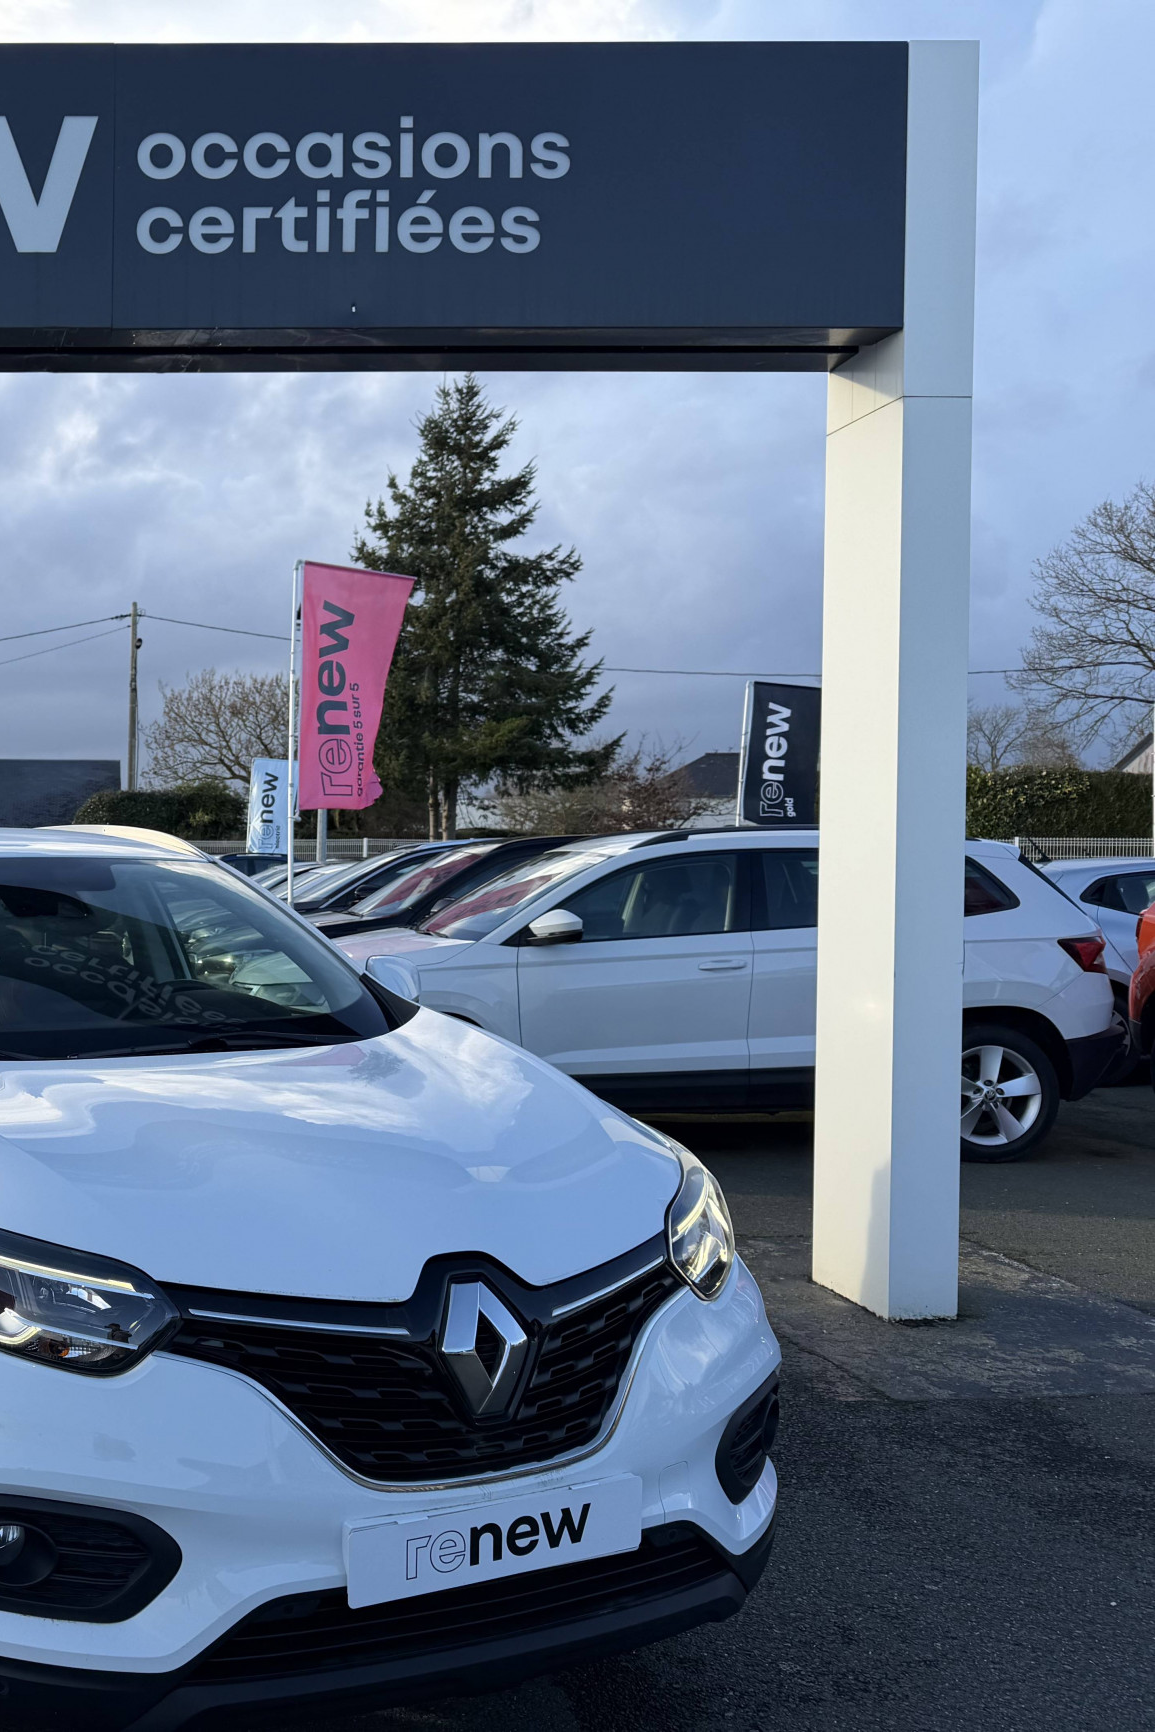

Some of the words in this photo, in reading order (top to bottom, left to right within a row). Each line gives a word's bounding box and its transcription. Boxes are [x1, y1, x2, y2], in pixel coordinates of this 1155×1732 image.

[137, 115, 570, 180] occasions
[136, 188, 541, 256] certifiées
[316, 600, 355, 797] renew
[350, 682, 359, 691] 5
[352, 694, 361, 718] sur
[353, 720, 363, 729] 5
[354, 732, 365, 797] garantie
[760, 702, 792, 817] renew
[258, 771, 279, 849] renew
[784, 797, 797, 817] gold
[406, 1502, 592, 1581] renew
